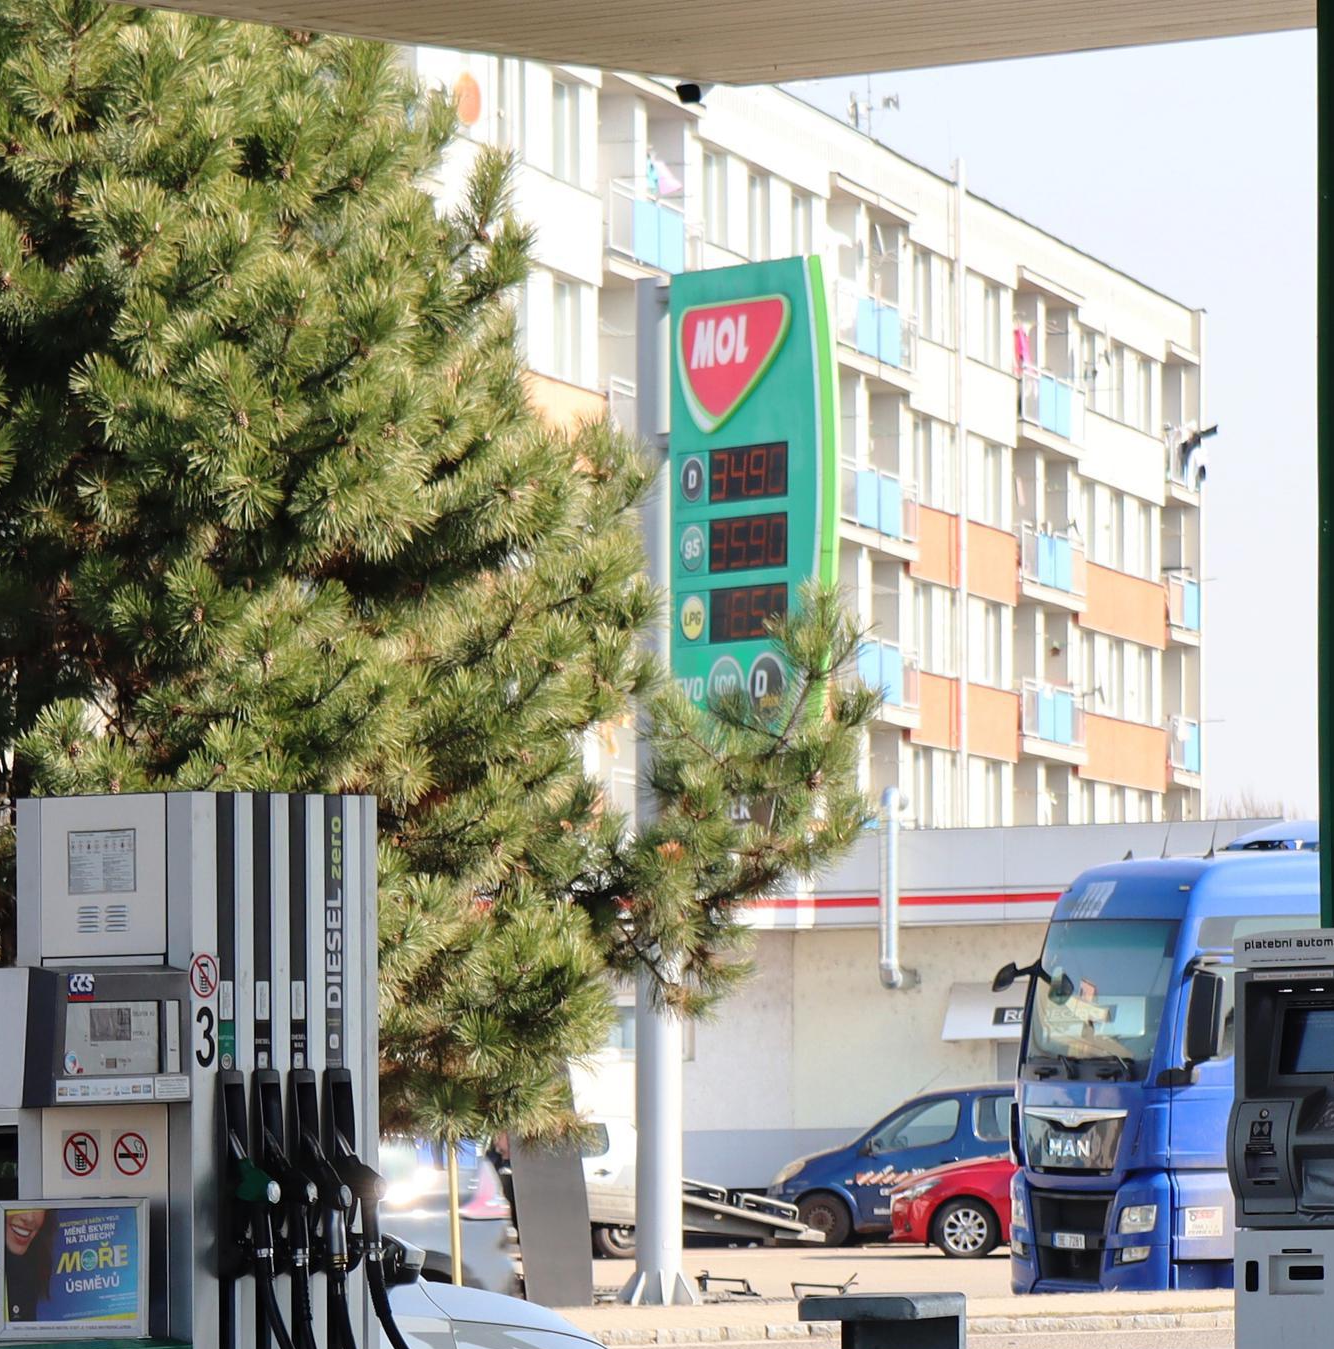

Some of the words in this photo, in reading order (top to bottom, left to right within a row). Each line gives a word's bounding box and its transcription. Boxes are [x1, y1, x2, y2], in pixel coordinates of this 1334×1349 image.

[690, 314, 750, 369] MOL
[685, 539, 701, 560] 95
[683, 611, 702, 627] LPG
[331, 816, 342, 880] zero
[326, 887, 342, 1009] DIESEL
[69, 973, 95, 992] CCS
[195, 1006, 216, 1068] 3
[1049, 1138, 1091, 1157] MAN
[65, 1235, 77, 1245] NA
